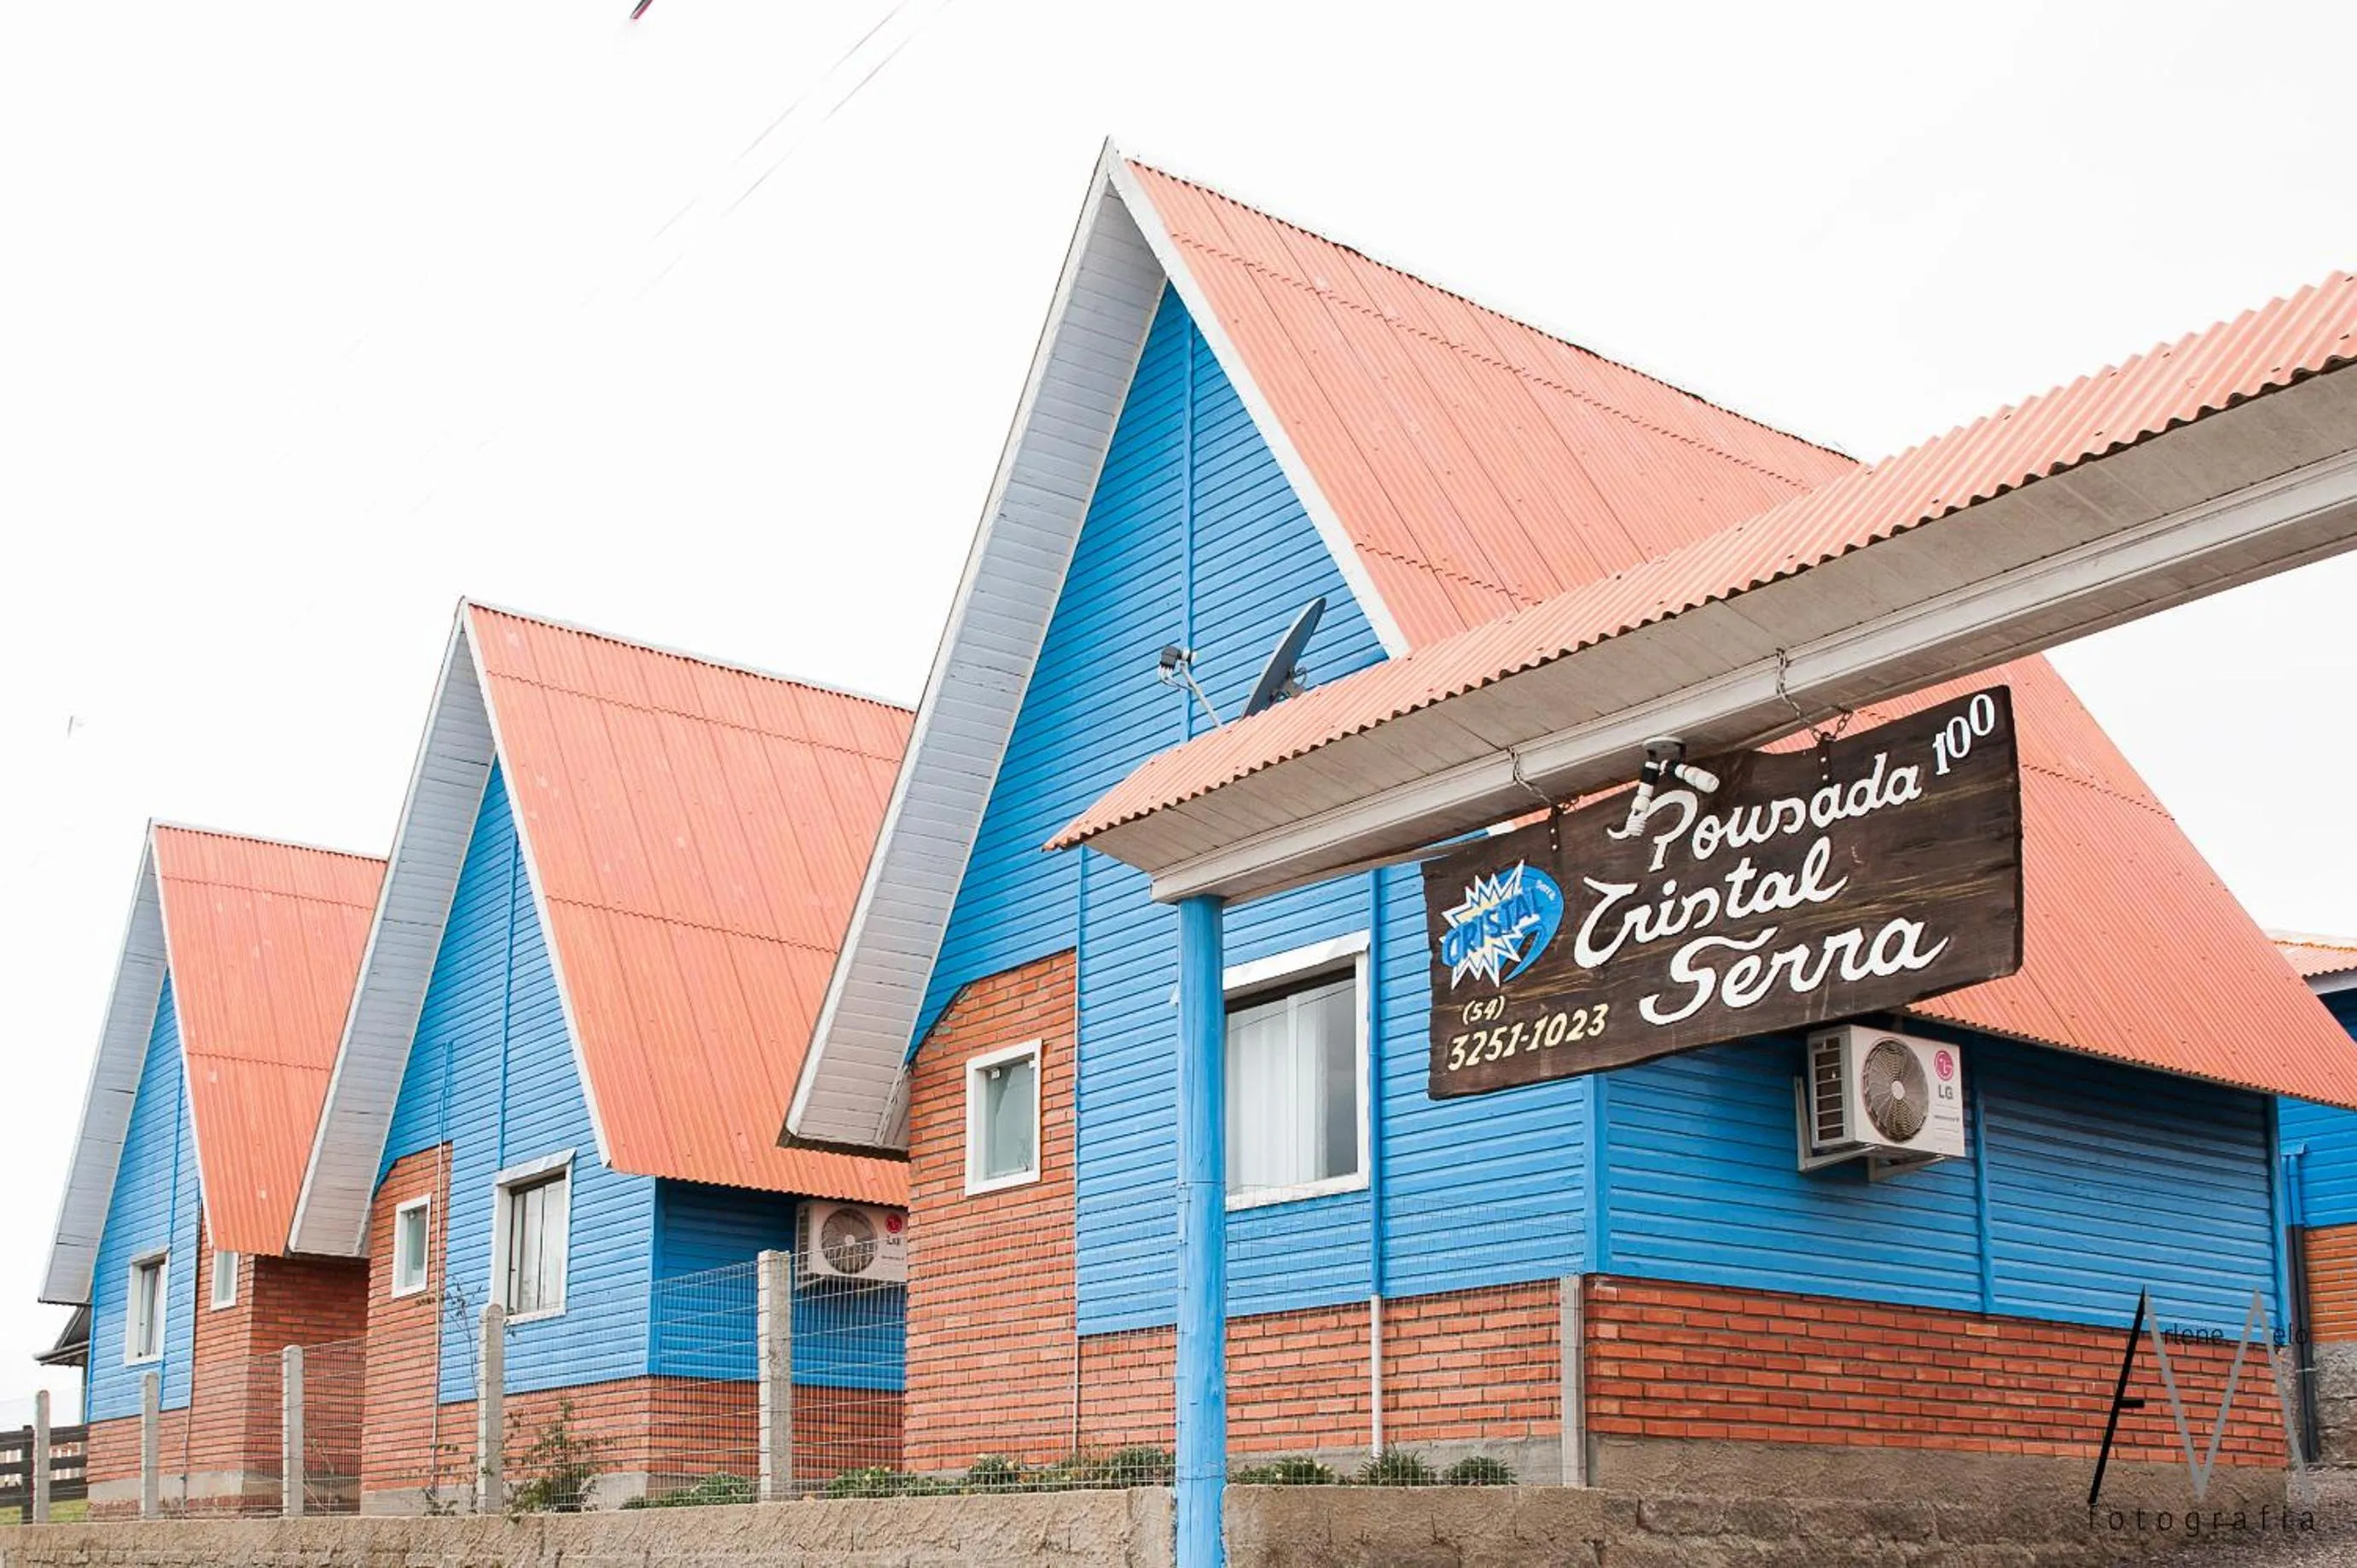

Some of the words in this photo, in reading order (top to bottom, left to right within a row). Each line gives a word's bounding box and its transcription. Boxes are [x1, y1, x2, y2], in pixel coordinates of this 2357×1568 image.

[1607, 752, 1924, 873] Pousada
[1932, 694, 1995, 775] 100
[1443, 887, 1544, 967] CRISTAL
[1574, 836, 1849, 969] Cristal
[1462, 995, 1506, 1026] (54)
[1639, 916, 1949, 1025] Serra
[1448, 1002, 1609, 1071] 3251-1023
[1938, 1084, 1954, 1101] LG
